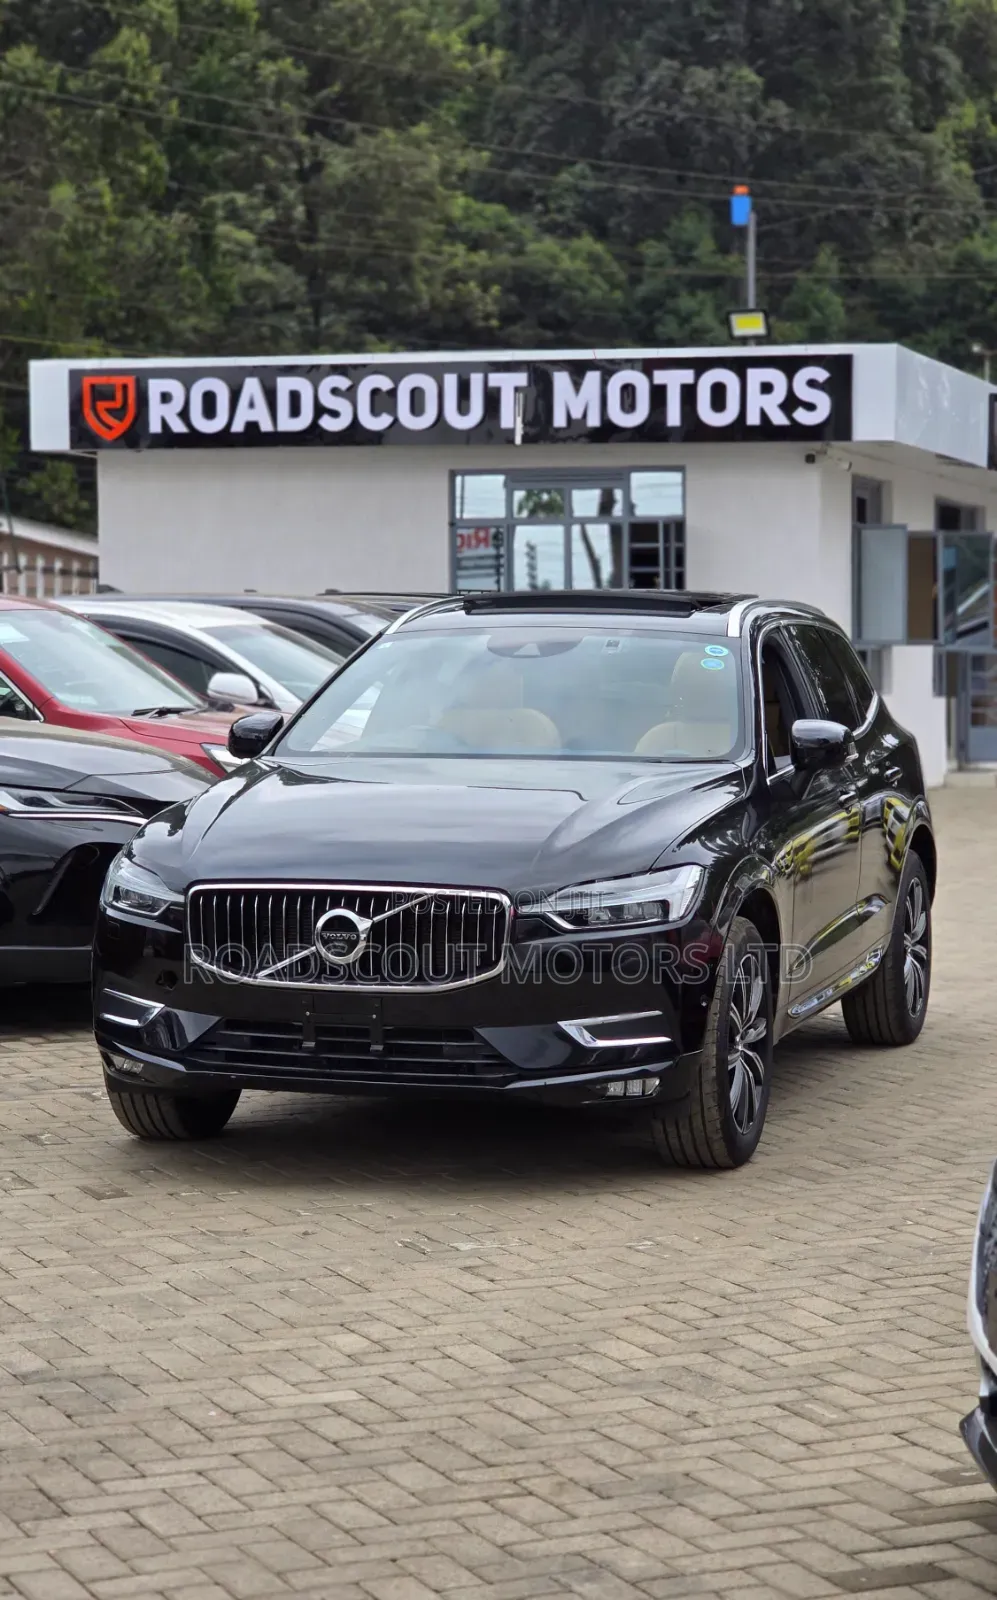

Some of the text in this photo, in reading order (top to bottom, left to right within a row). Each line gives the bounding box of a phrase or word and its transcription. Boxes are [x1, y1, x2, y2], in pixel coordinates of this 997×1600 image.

[148, 367, 831, 434] ROADSCOUT MOTORS
[321, 932, 357, 940] VOLVO
